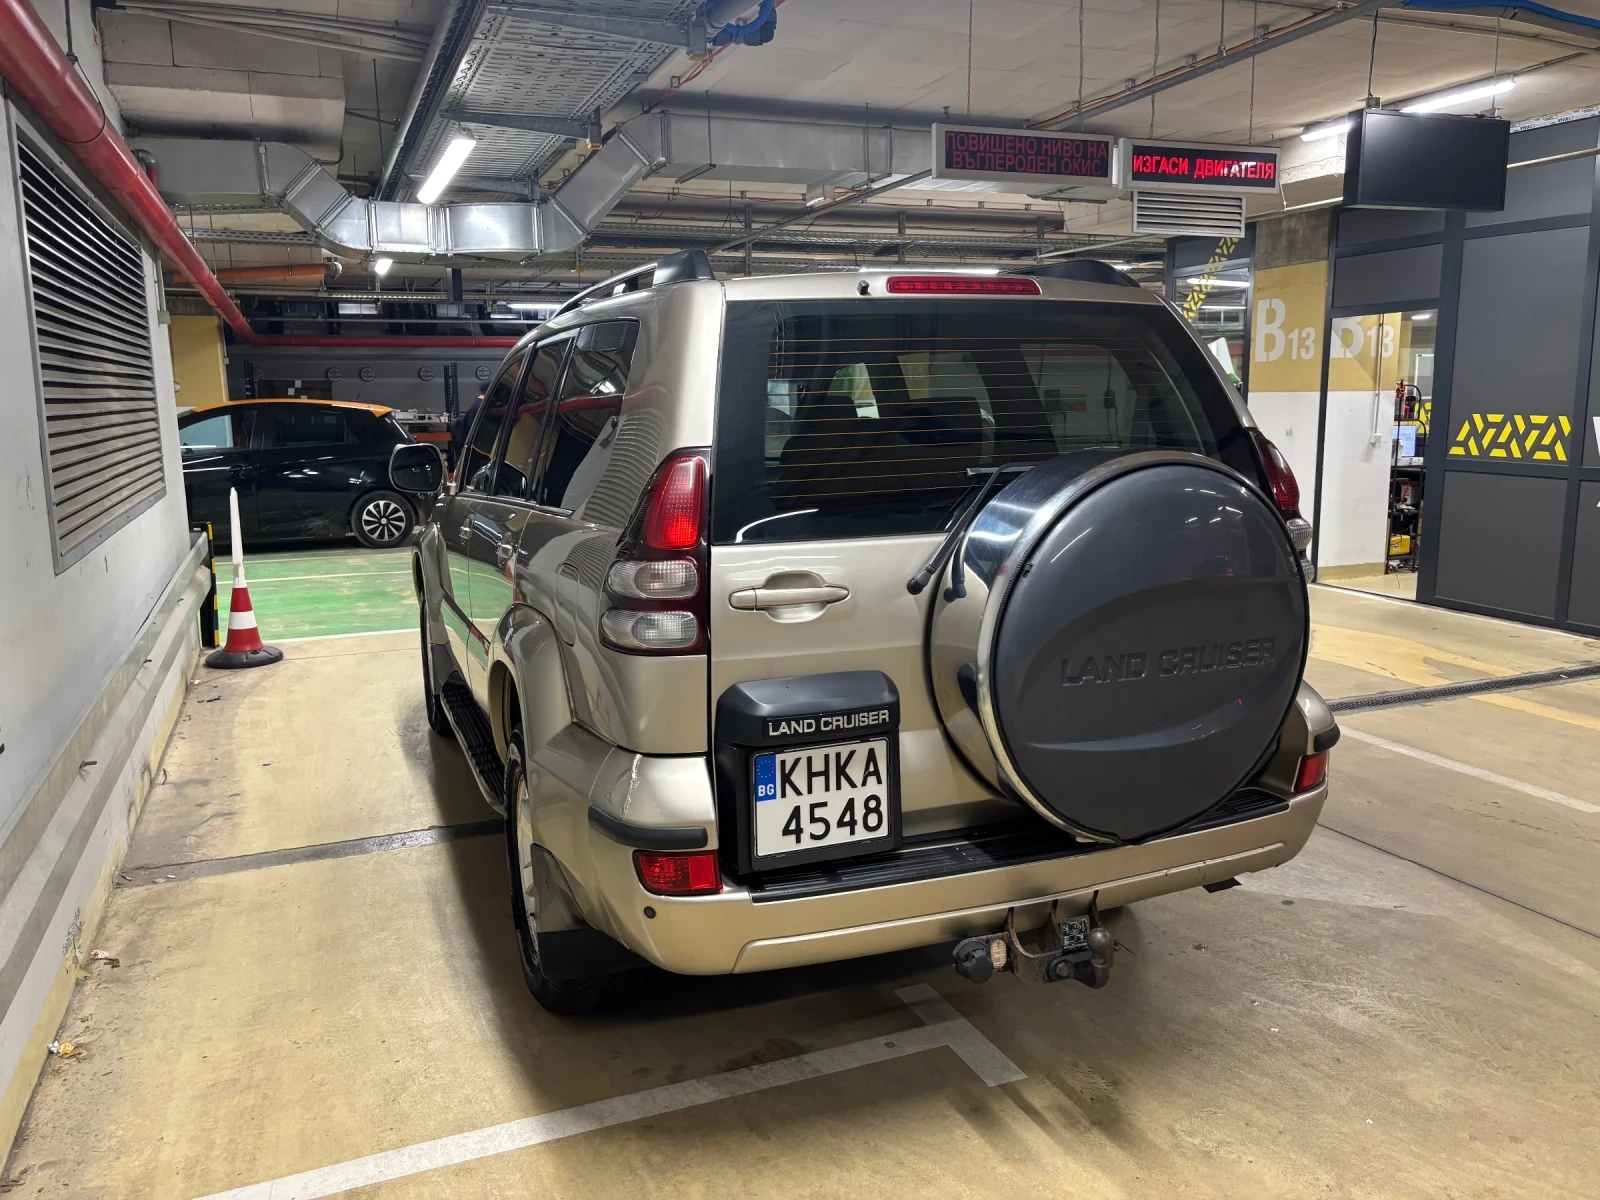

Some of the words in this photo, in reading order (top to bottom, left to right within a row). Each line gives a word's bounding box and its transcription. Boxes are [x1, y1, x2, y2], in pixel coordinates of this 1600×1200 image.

[945, 132, 1037, 155] ПОВИШЕНО
[1038, 139, 1083, 157] НИВО
[1087, 143, 1107, 159] НА
[952, 151, 1057, 174] ВЪГЛЕРОДЕН
[1061, 158, 1101, 176] ОКИС
[1133, 154, 1189, 176] ИЗГАСИ
[1194, 158, 1275, 180] ДВИГАТЕЛЯ
[1061, 651, 1148, 687] LAND
[1159, 636, 1276, 678] CRUISER
[768, 719, 816, 736] LAND
[820, 709, 890, 731] CRUISER
[780, 747, 883, 799] KHKA
[757, 783, 775, 797] BG
[781, 794, 883, 844] 4548
